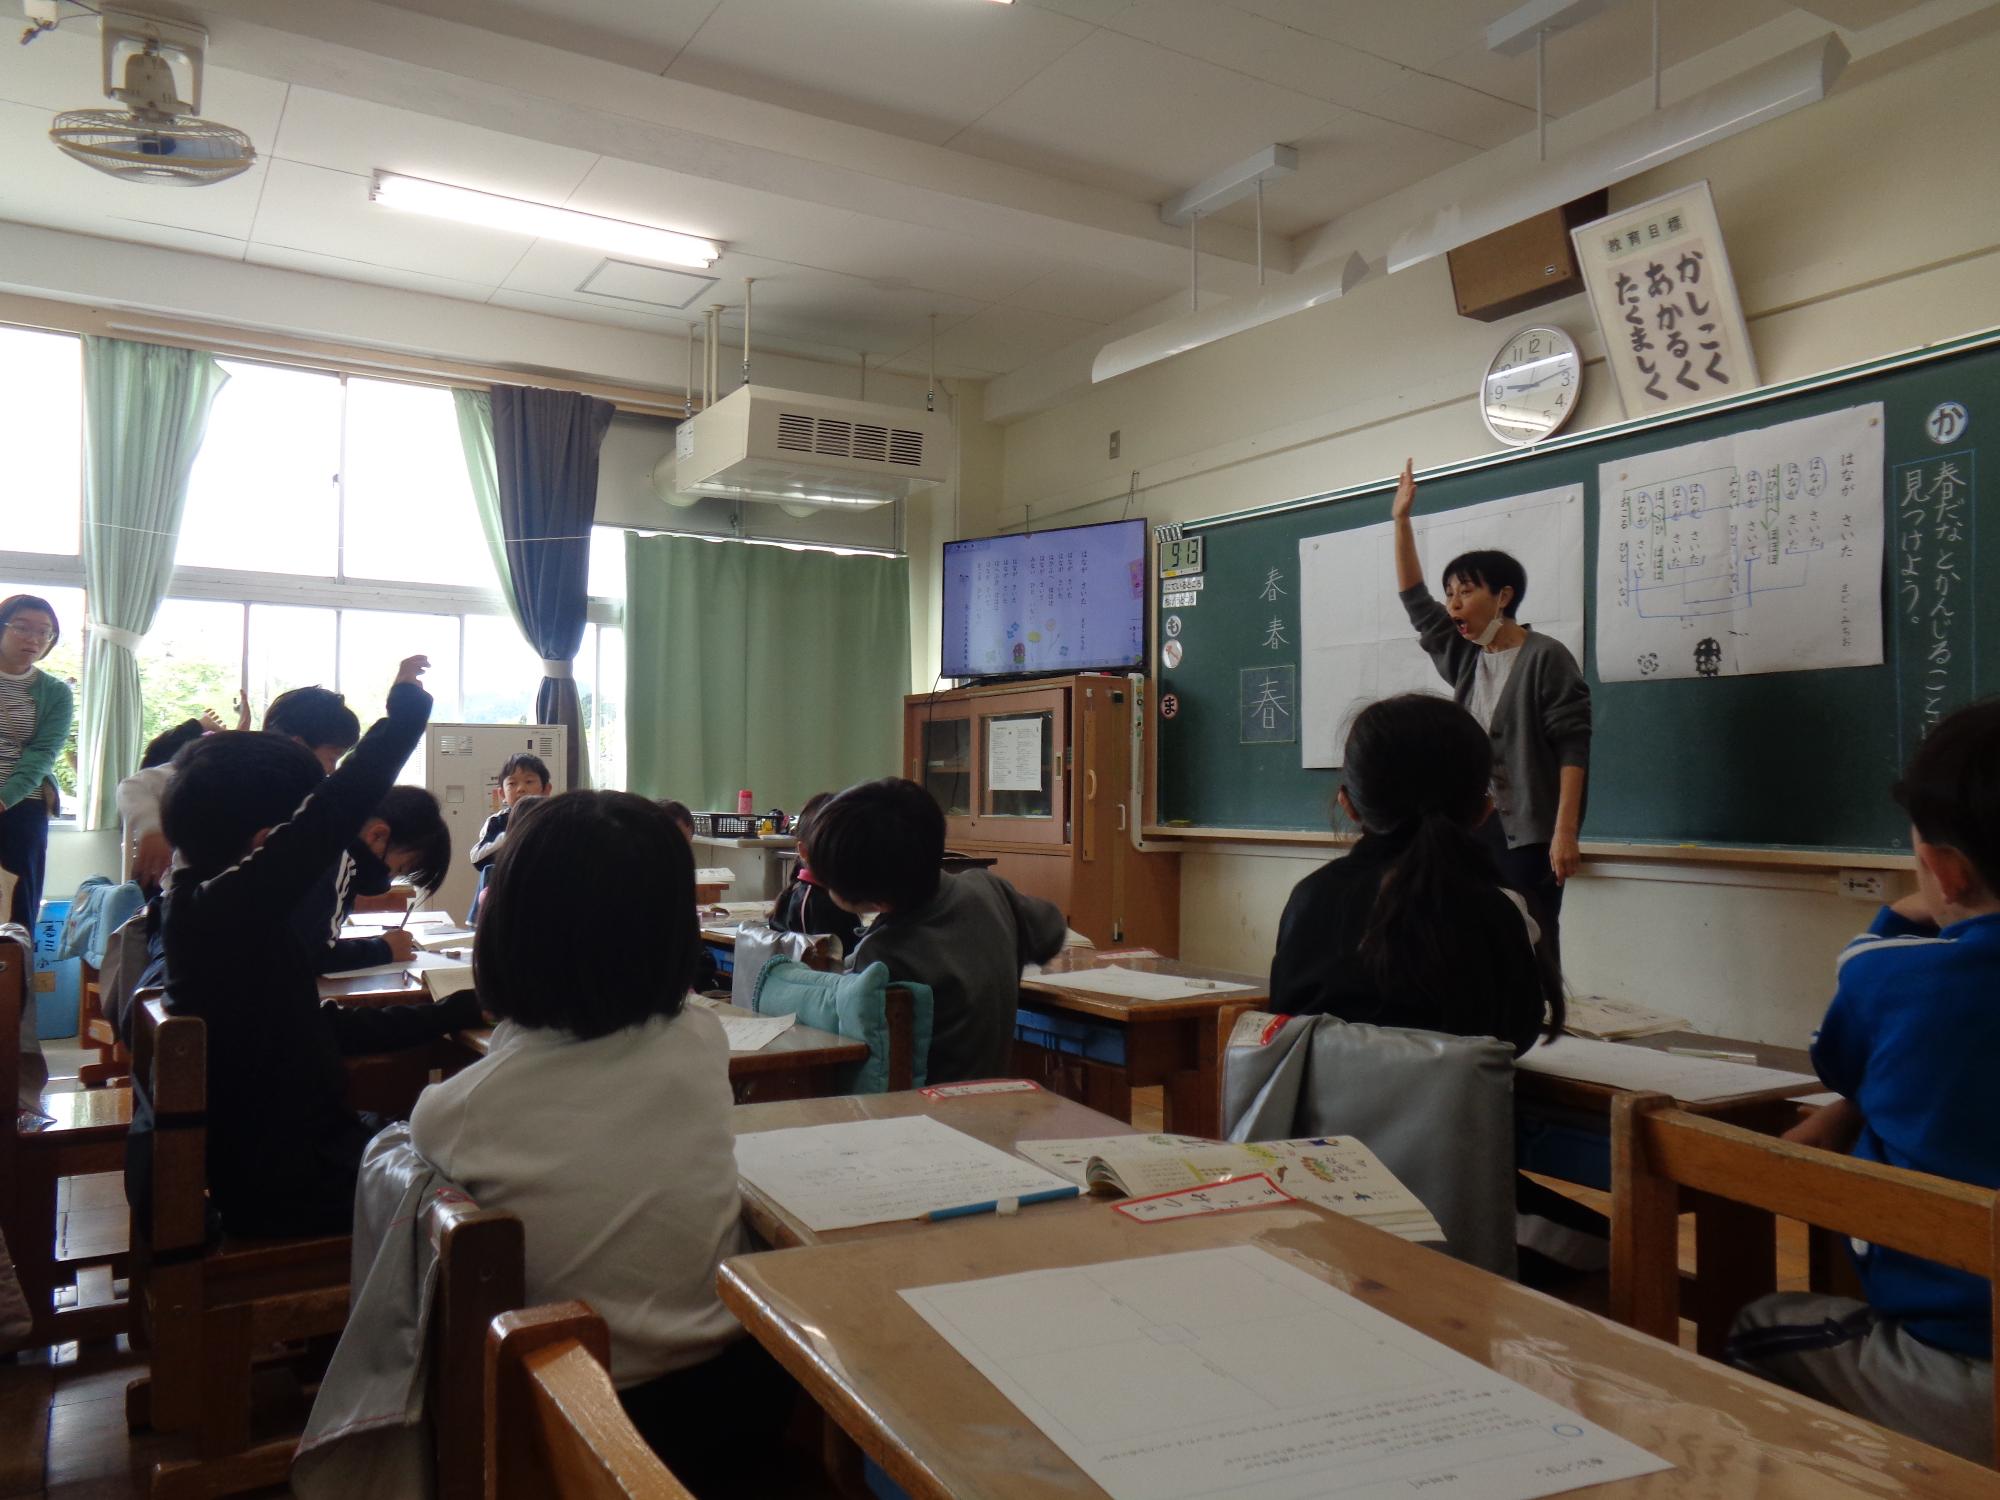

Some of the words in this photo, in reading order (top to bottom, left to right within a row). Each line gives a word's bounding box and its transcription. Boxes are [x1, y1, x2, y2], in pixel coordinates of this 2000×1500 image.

[1644, 261, 1700, 392] あかるく
[1676, 251, 1730, 384] かしこく
[1529, 338, 1540, 354] 12
[1615, 272, 1669, 400] たくましく
[1513, 347, 1522, 362] 11
[1495, 385, 1504, 400] 9
[1555, 393, 1563, 408] 4
[1932, 407, 1964, 437] か
[1259, 566, 1288, 601] 春
[1921, 461, 1967, 740] 春だなとかんじること
[1167, 618, 1180, 635] も
[1262, 615, 1290, 649] 春
[1164, 696, 1176, 715] ま
[1251, 672, 1289, 728] 春
